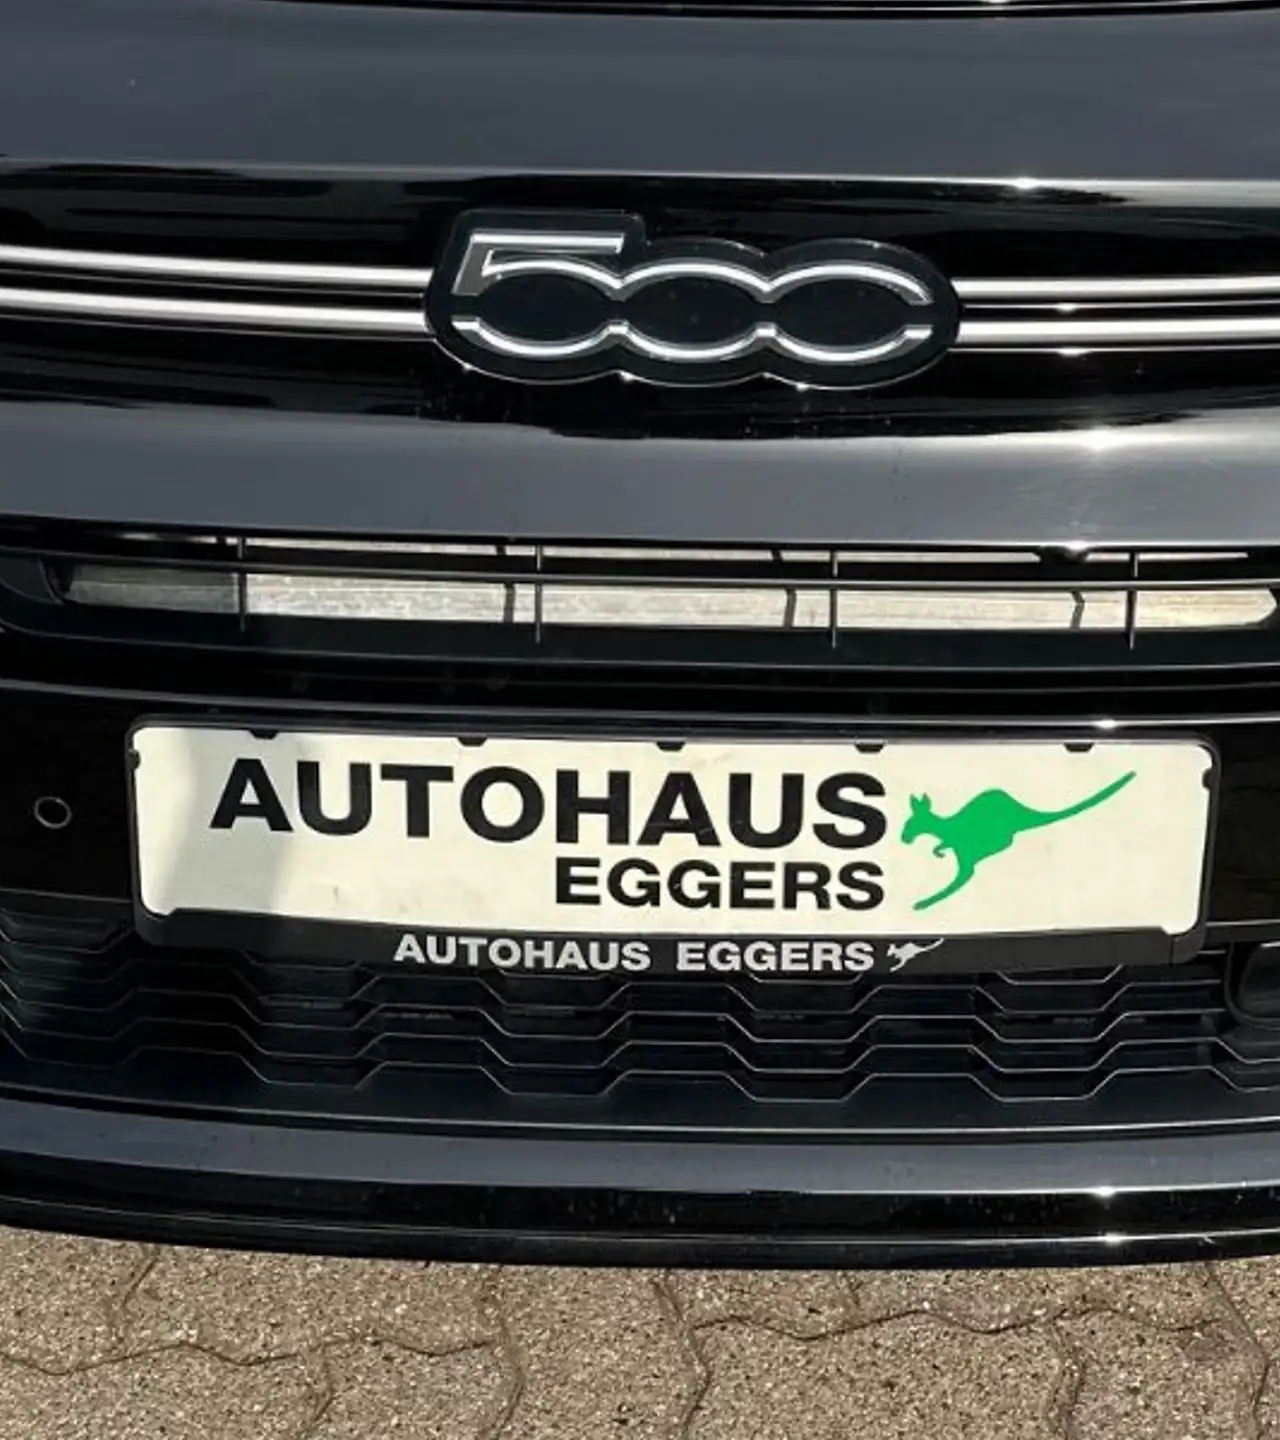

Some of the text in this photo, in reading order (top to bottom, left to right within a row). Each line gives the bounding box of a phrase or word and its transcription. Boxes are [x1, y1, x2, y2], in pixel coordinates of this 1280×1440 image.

[451, 228, 934, 364] 500
[209, 756, 888, 850] AUTOHAUS
[555, 855, 885, 911] EGGERS
[393, 932, 875, 973] AUTOHAUS EGGERS
